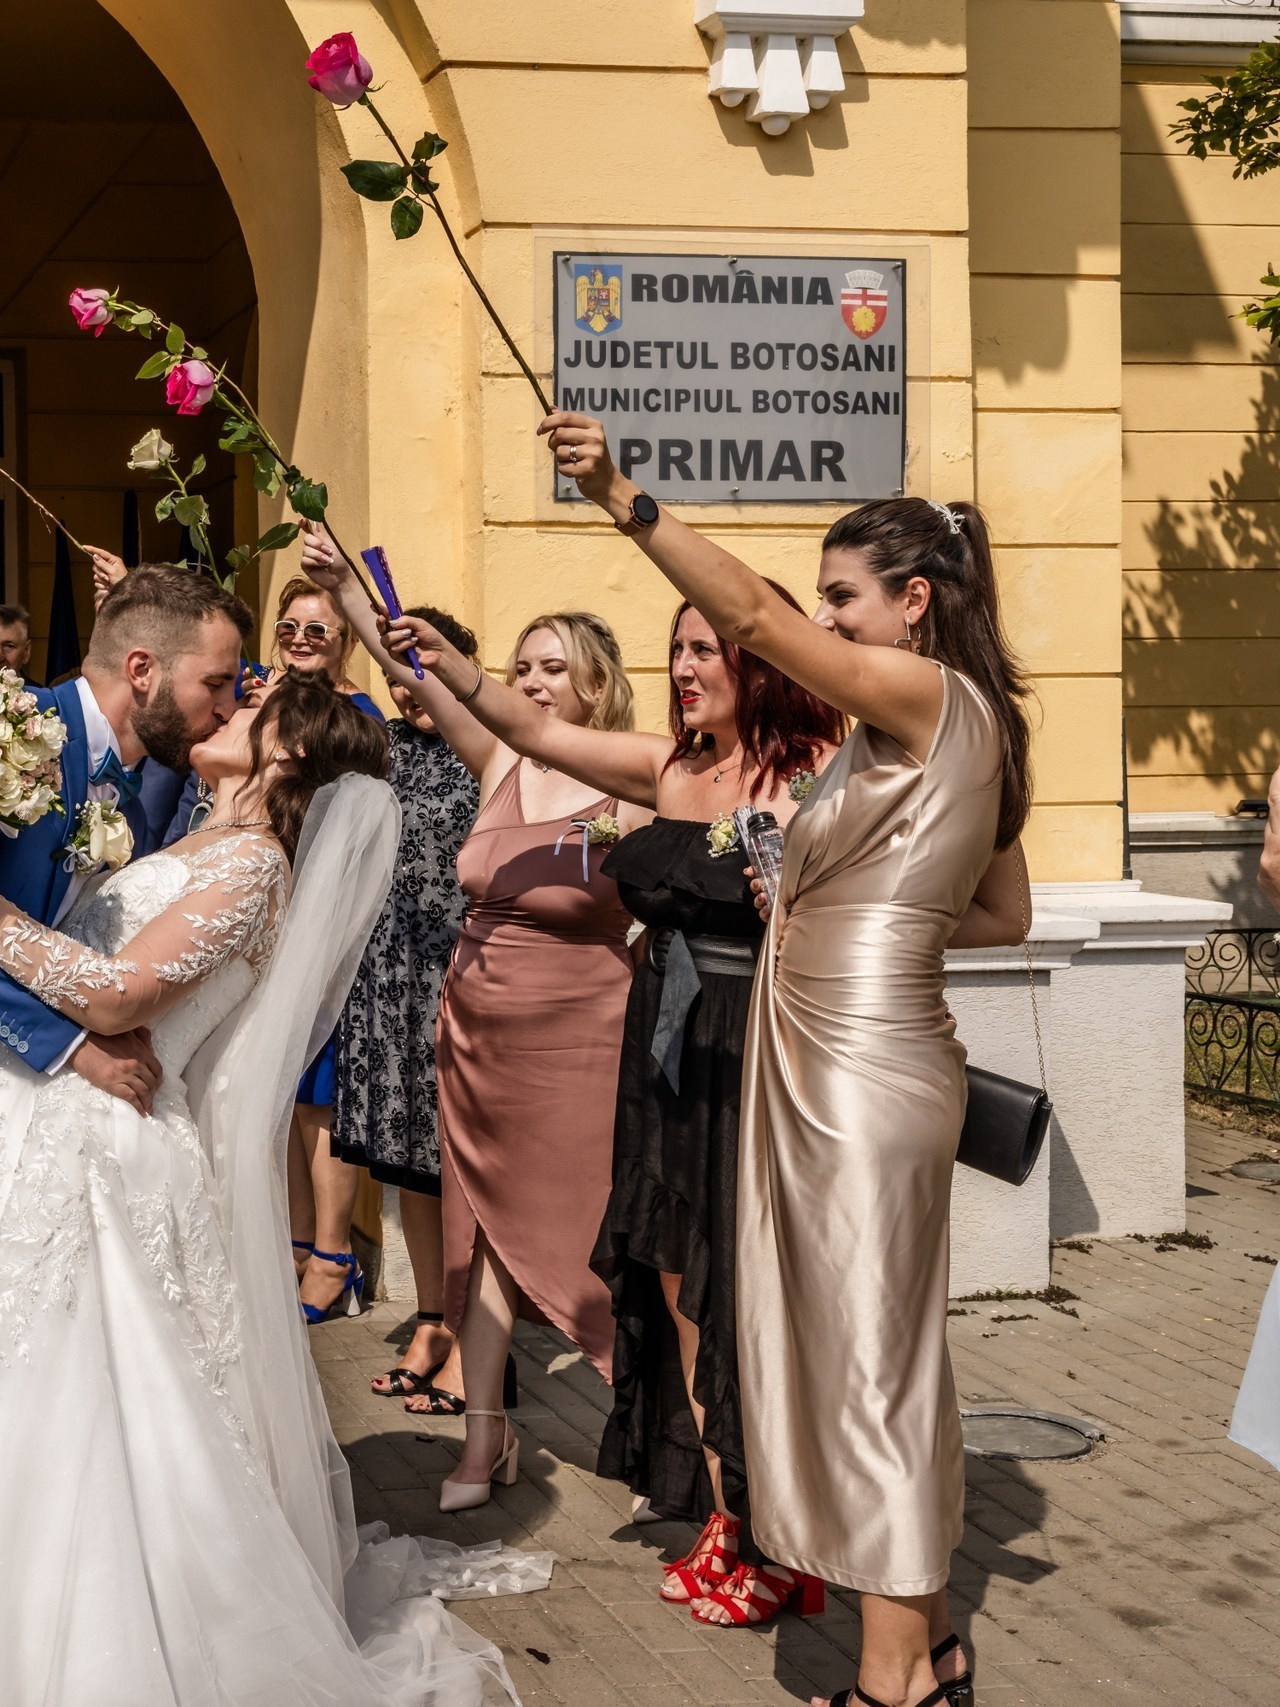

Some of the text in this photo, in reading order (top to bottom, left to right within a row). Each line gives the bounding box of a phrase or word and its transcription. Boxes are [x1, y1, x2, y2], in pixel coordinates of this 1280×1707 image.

[631, 269, 834, 305] ROMÂNIA
[564, 340, 895, 372] JUDETUL BOTOSANI
[562, 387, 900, 416] MUNICIPIUL BOTOSANI
[620, 438, 847, 482] PRIMAR
